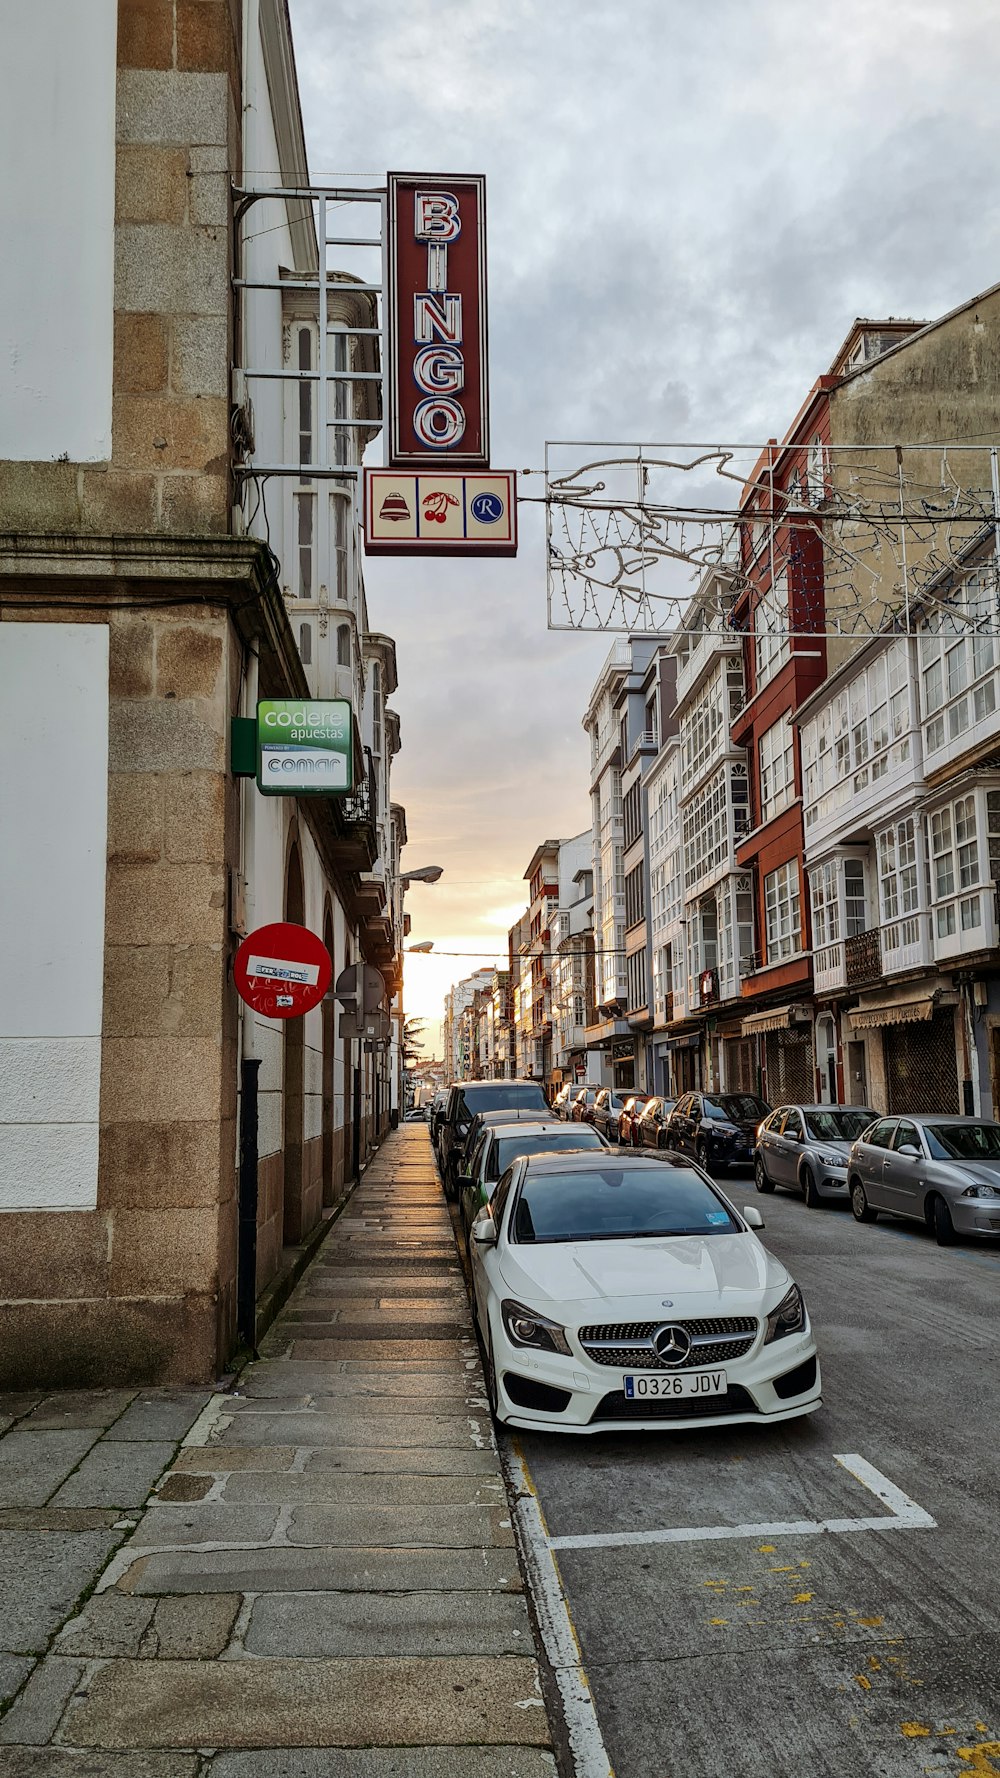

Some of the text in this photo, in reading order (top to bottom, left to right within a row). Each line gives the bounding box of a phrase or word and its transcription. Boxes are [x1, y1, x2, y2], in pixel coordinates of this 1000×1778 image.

[413, 190, 466, 450] BINGO
[264, 706, 343, 727] codere
[290, 727, 344, 742] apuestas
[267, 758, 341, 773] comar
[637, 1378, 683, 1396] 0326
[690, 1374, 721, 1394] JDV
